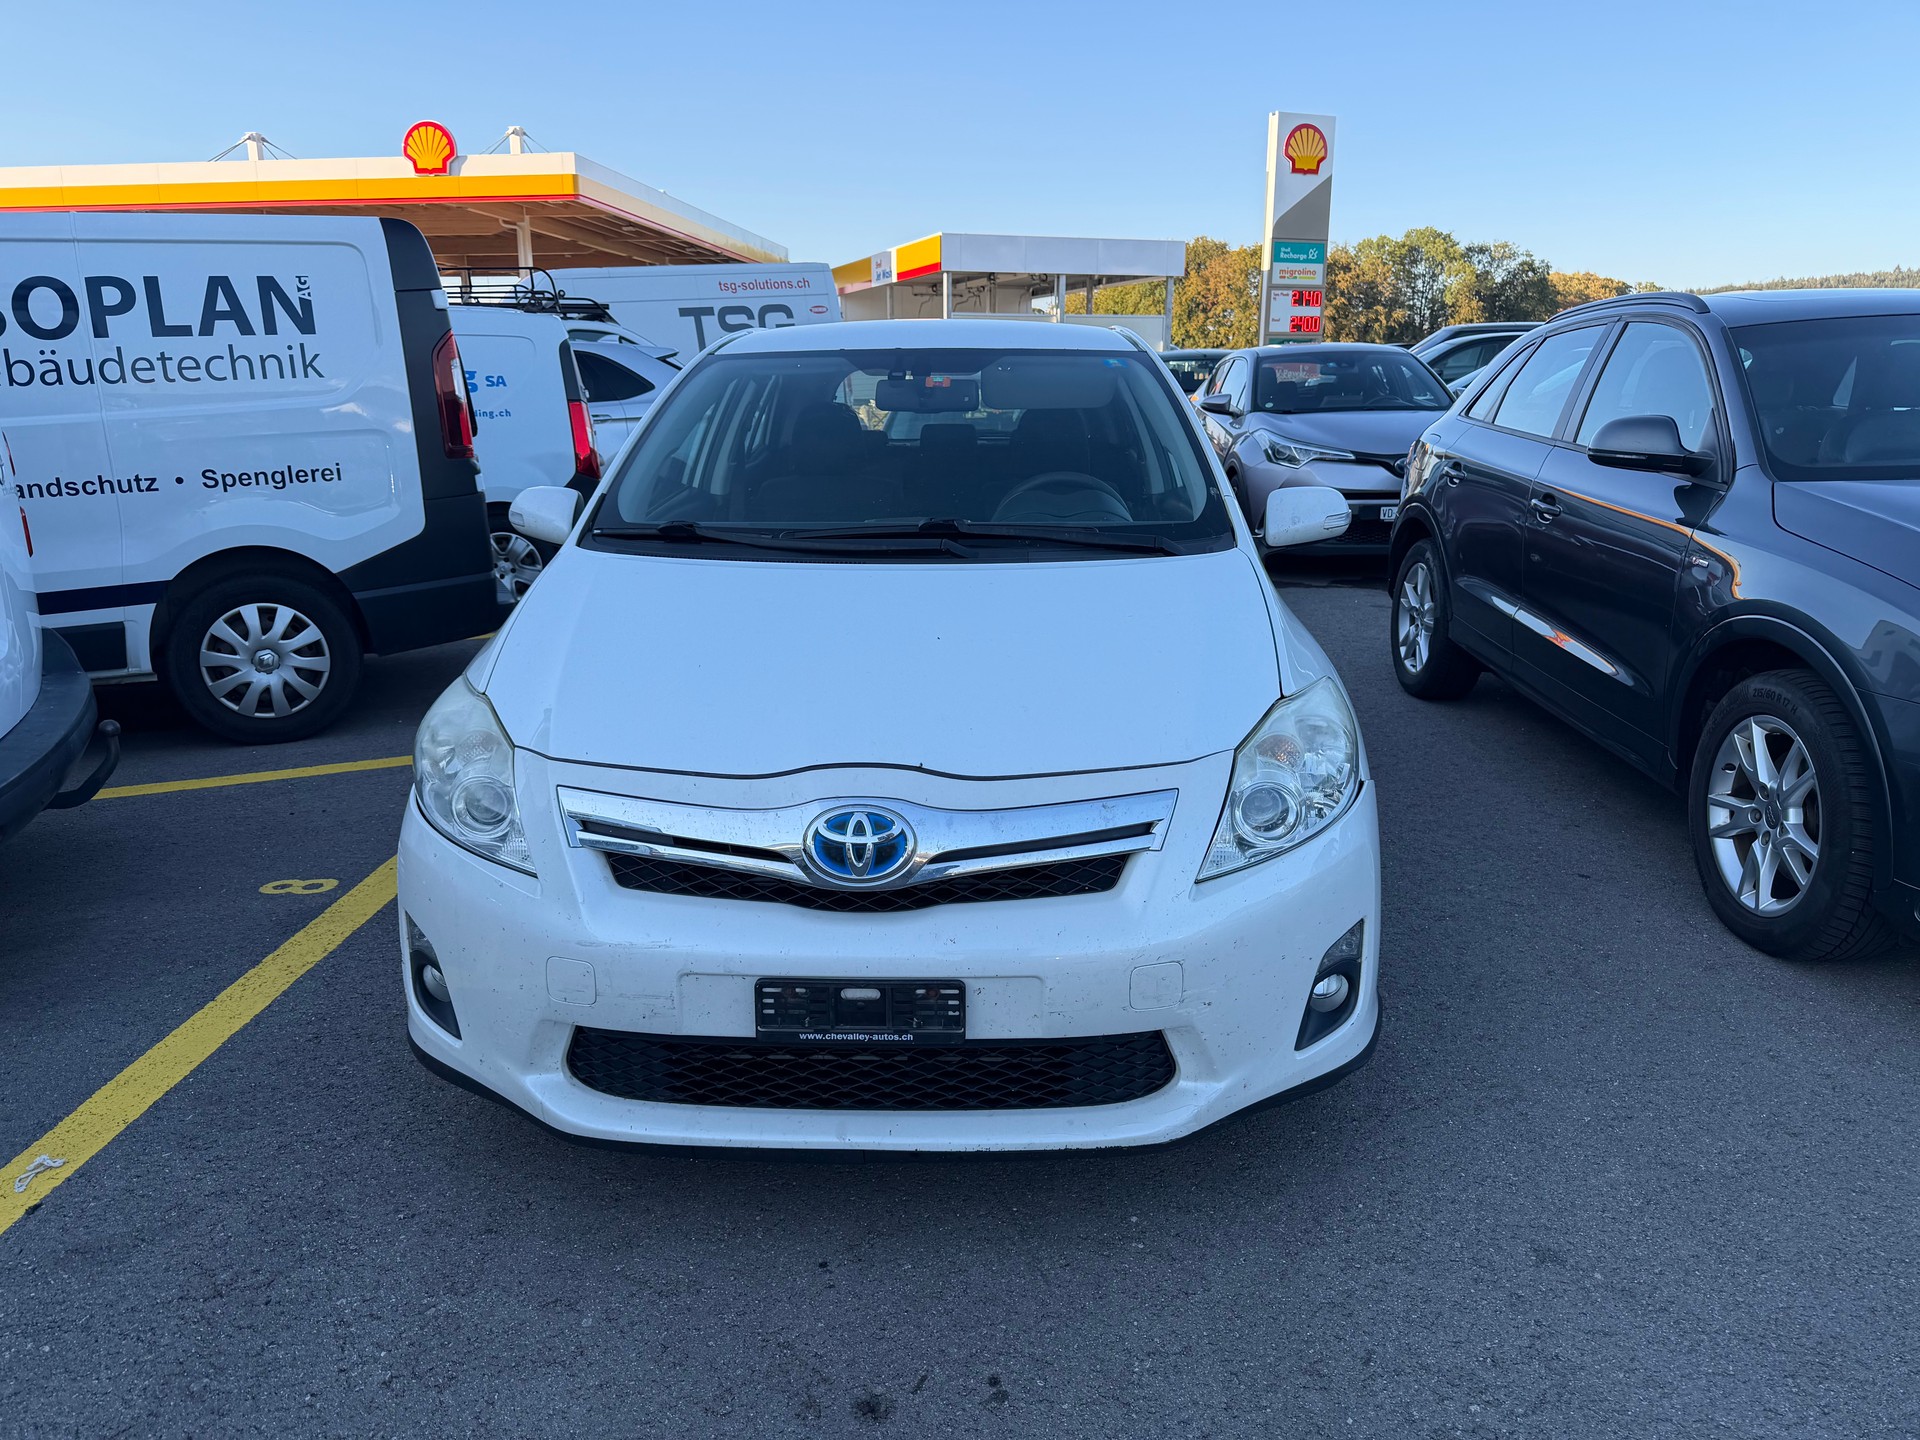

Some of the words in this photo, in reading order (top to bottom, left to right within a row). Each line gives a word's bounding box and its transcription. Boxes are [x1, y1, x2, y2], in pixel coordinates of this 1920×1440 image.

[1280, 252, 1307, 261] Recharge
[1279, 267, 1317, 277] migrolino
[296, 275, 313, 300] AG
[718, 277, 811, 294] tsg-solutions.ch
[0, 275, 317, 341] OPLAN
[0, 343, 325, 388] bäudetechnik
[485, 375, 507, 387] SA
[200, 462, 342, 492] Spenglerei
[1382, 508, 1393, 518] VD
[799, 1032, 914, 1042] www.chevalley-autos.ch
